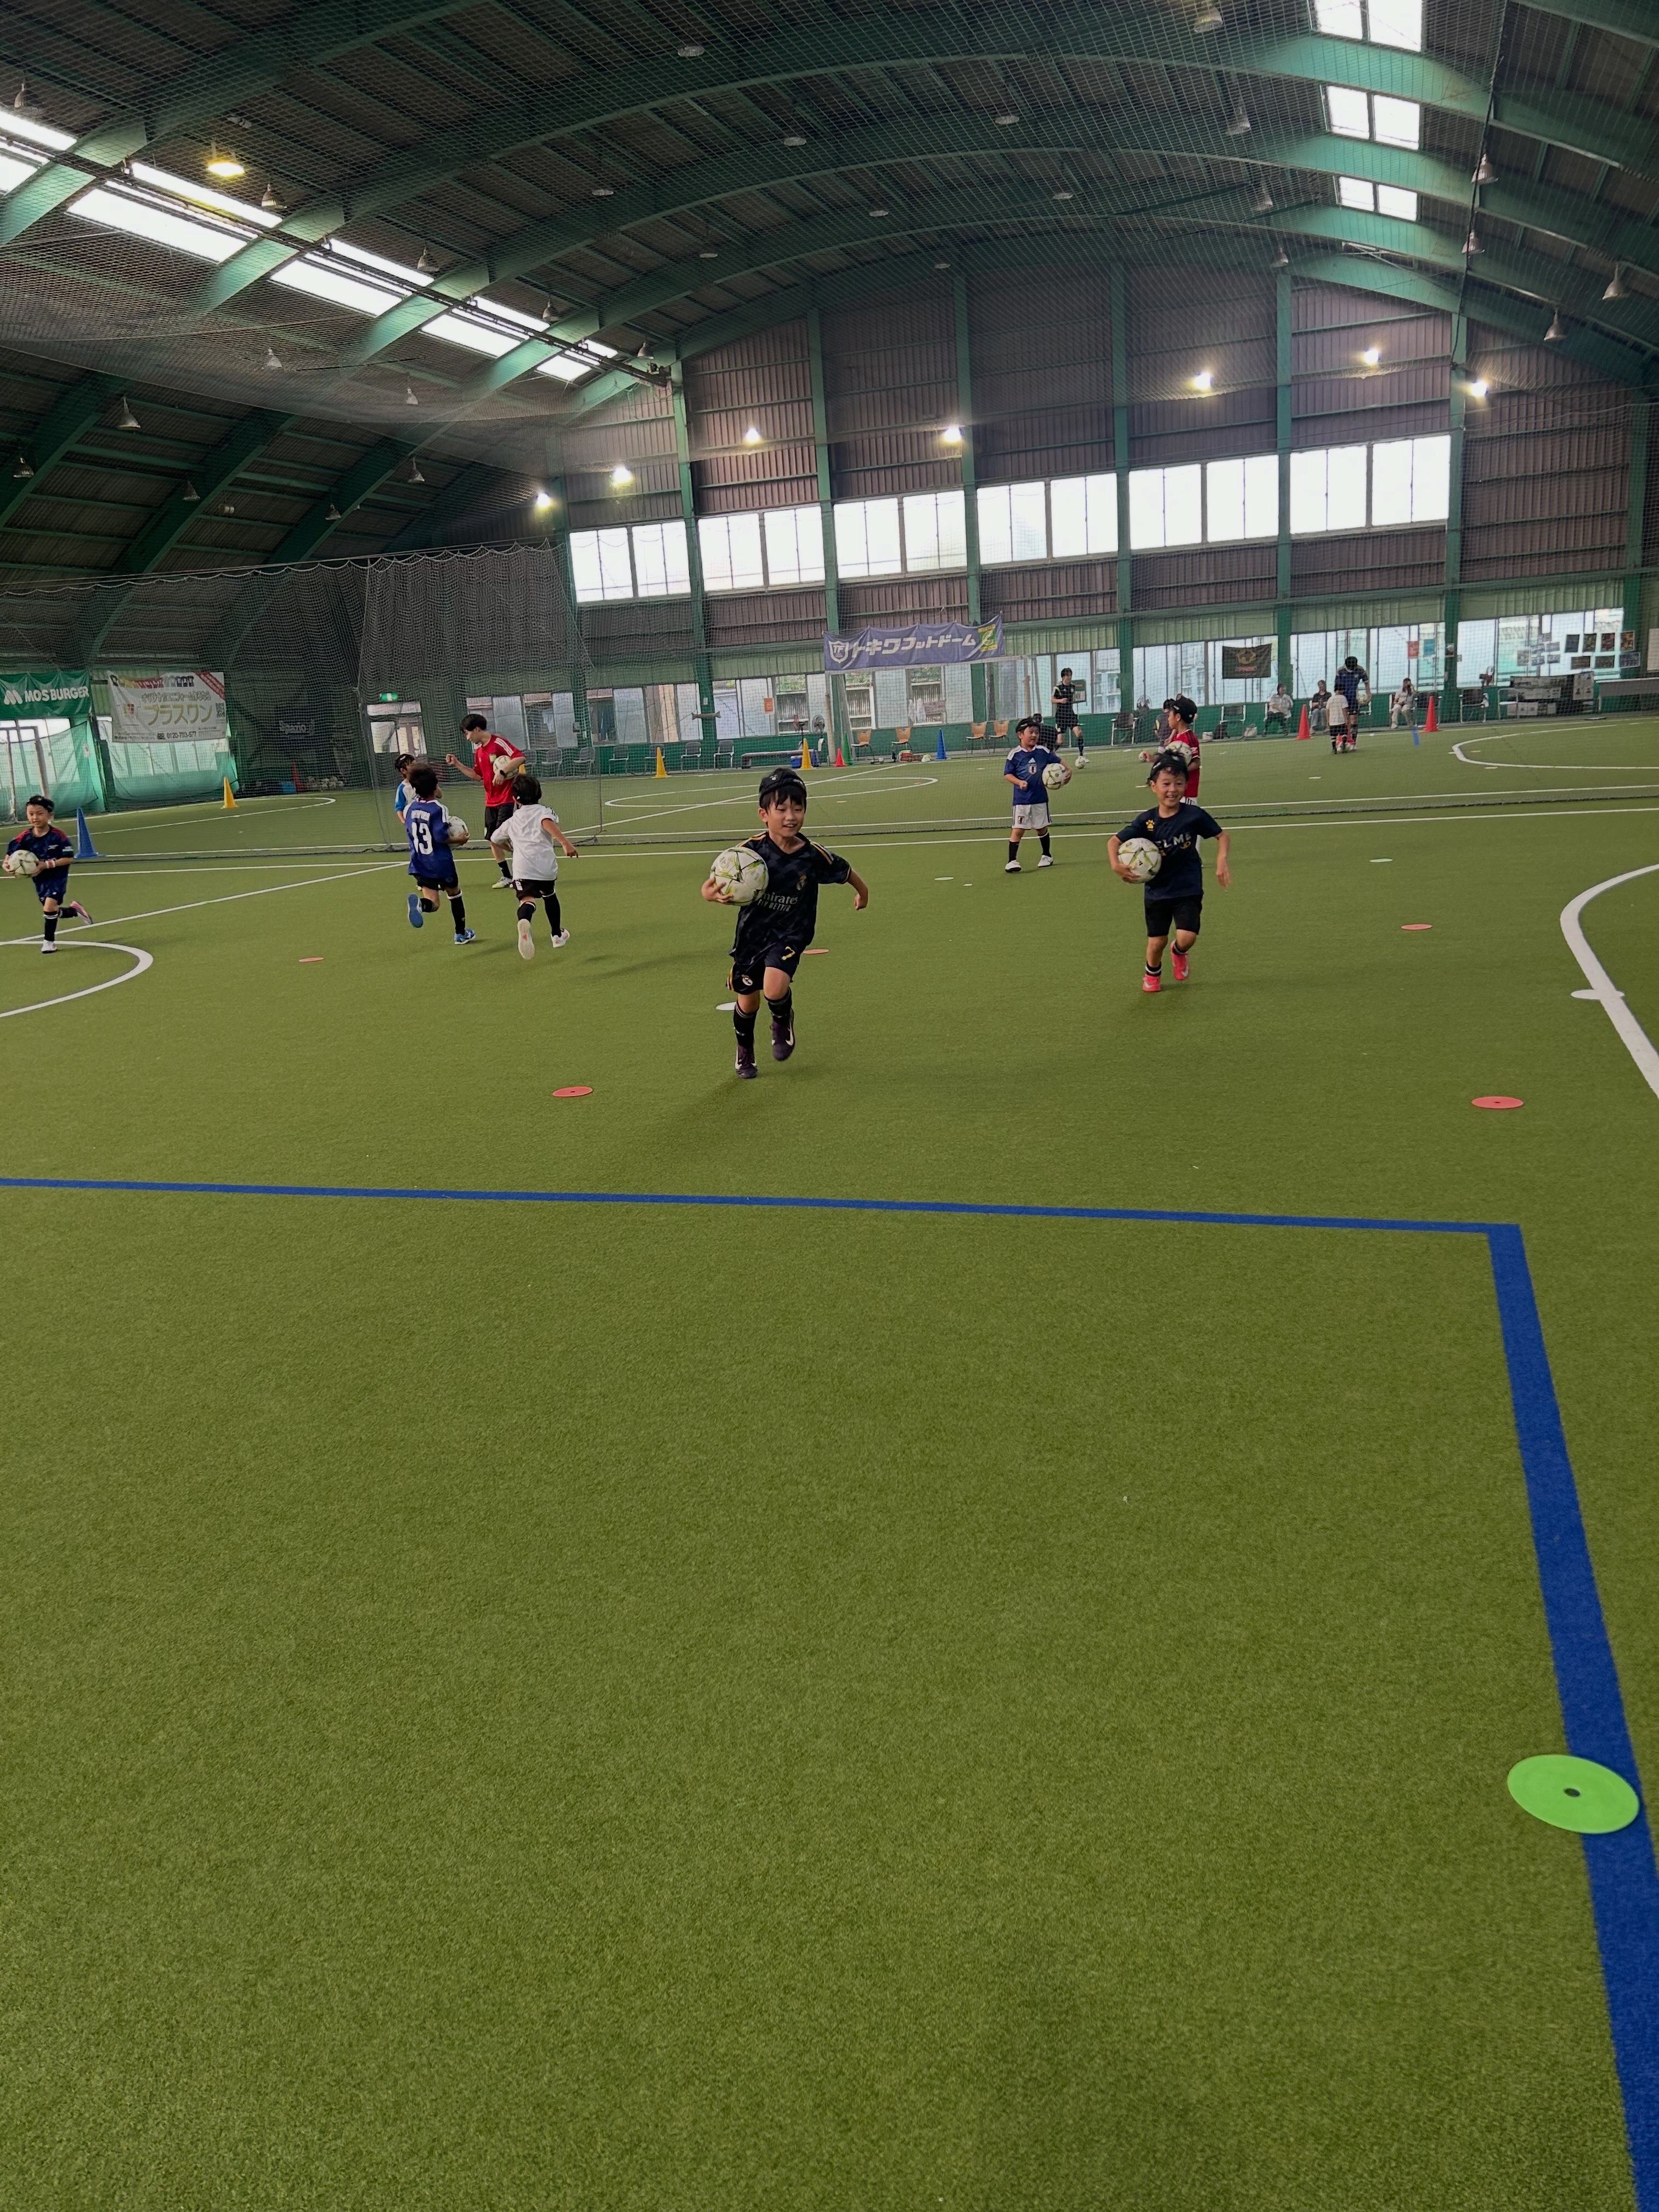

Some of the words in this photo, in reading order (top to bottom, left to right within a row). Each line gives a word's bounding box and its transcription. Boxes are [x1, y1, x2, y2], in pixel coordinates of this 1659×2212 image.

[851, 634, 976, 658] トキワフットドーム
[24, 690, 50, 702] MOS
[50, 686, 89, 701] BURGER
[144, 704, 212, 726] プラスワン
[411, 822, 433, 853] 13
[1155, 832, 1192, 849] ELME
[763, 892, 798, 905] mirates
[769, 902, 792, 912] BETTER
[781, 946, 795, 961] 7
